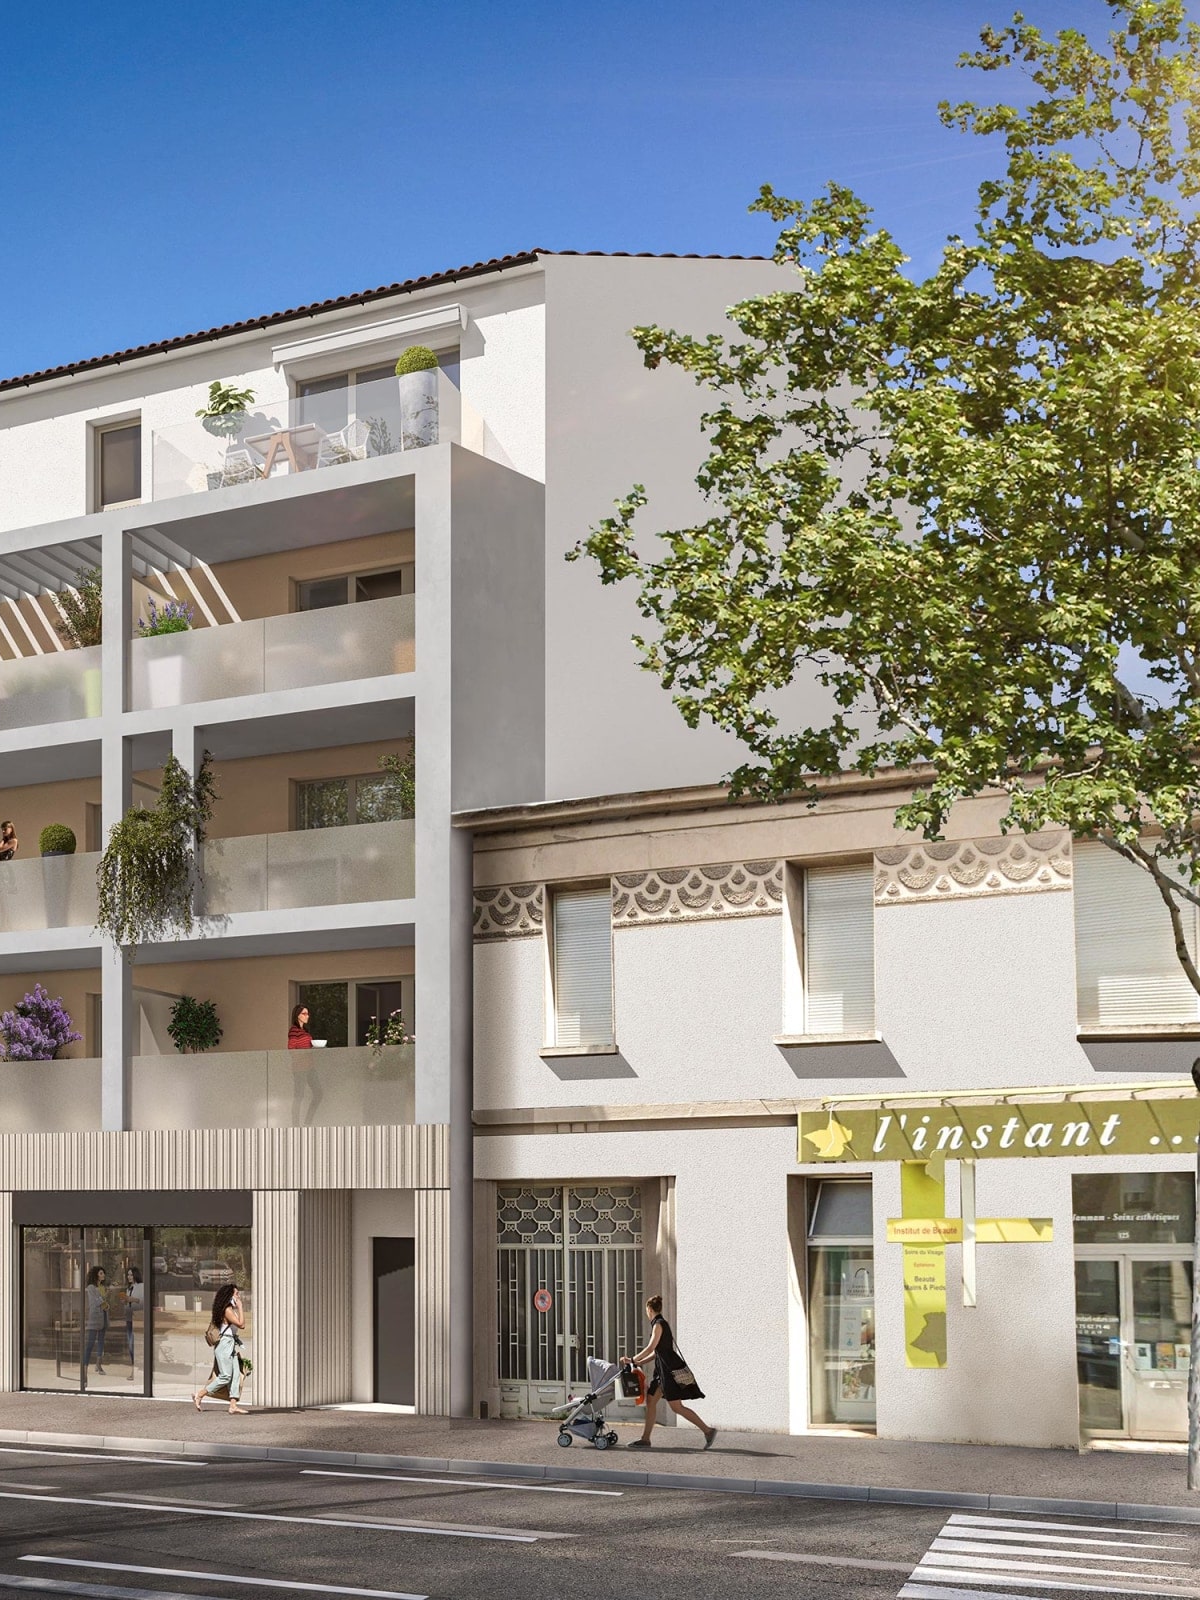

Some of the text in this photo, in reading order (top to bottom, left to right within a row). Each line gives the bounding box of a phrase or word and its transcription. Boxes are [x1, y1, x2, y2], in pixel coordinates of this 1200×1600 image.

[872, 1113, 1121, 1153] l'instant
[893, 1227, 920, 1235] Institut
[921, 1227, 931, 1235] de
